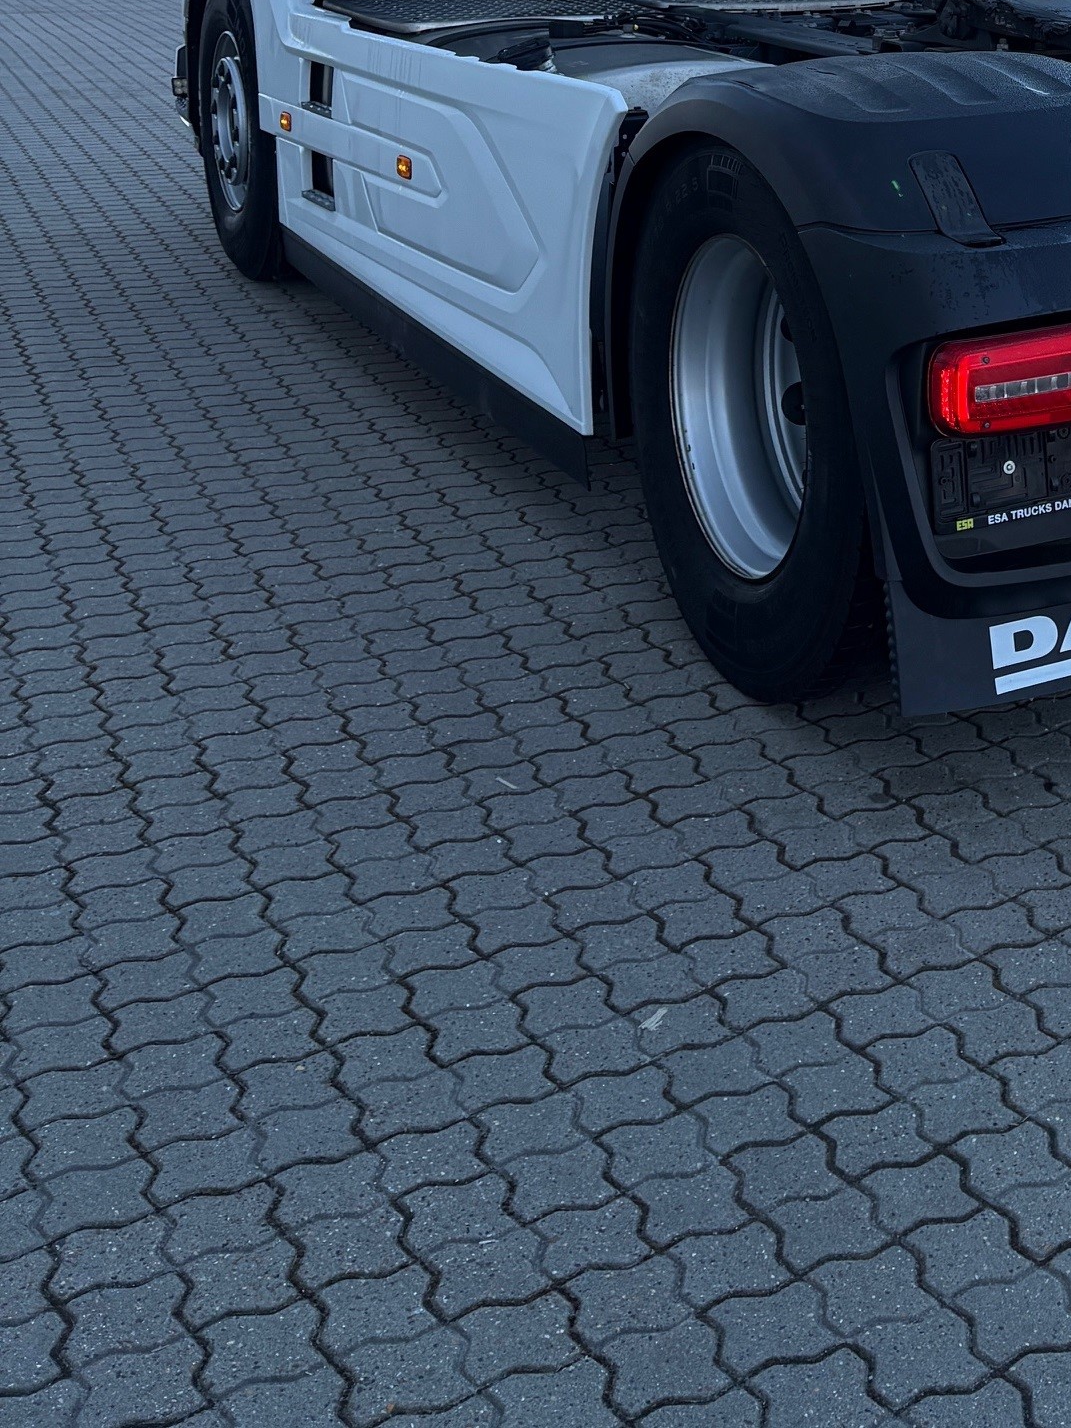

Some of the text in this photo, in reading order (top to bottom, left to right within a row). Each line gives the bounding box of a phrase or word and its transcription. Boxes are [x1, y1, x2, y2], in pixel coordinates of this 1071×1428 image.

[987, 512, 1009, 526] ESA
[1010, 503, 1053, 521] TRUCKS
[956, 518, 974, 532] ESA
